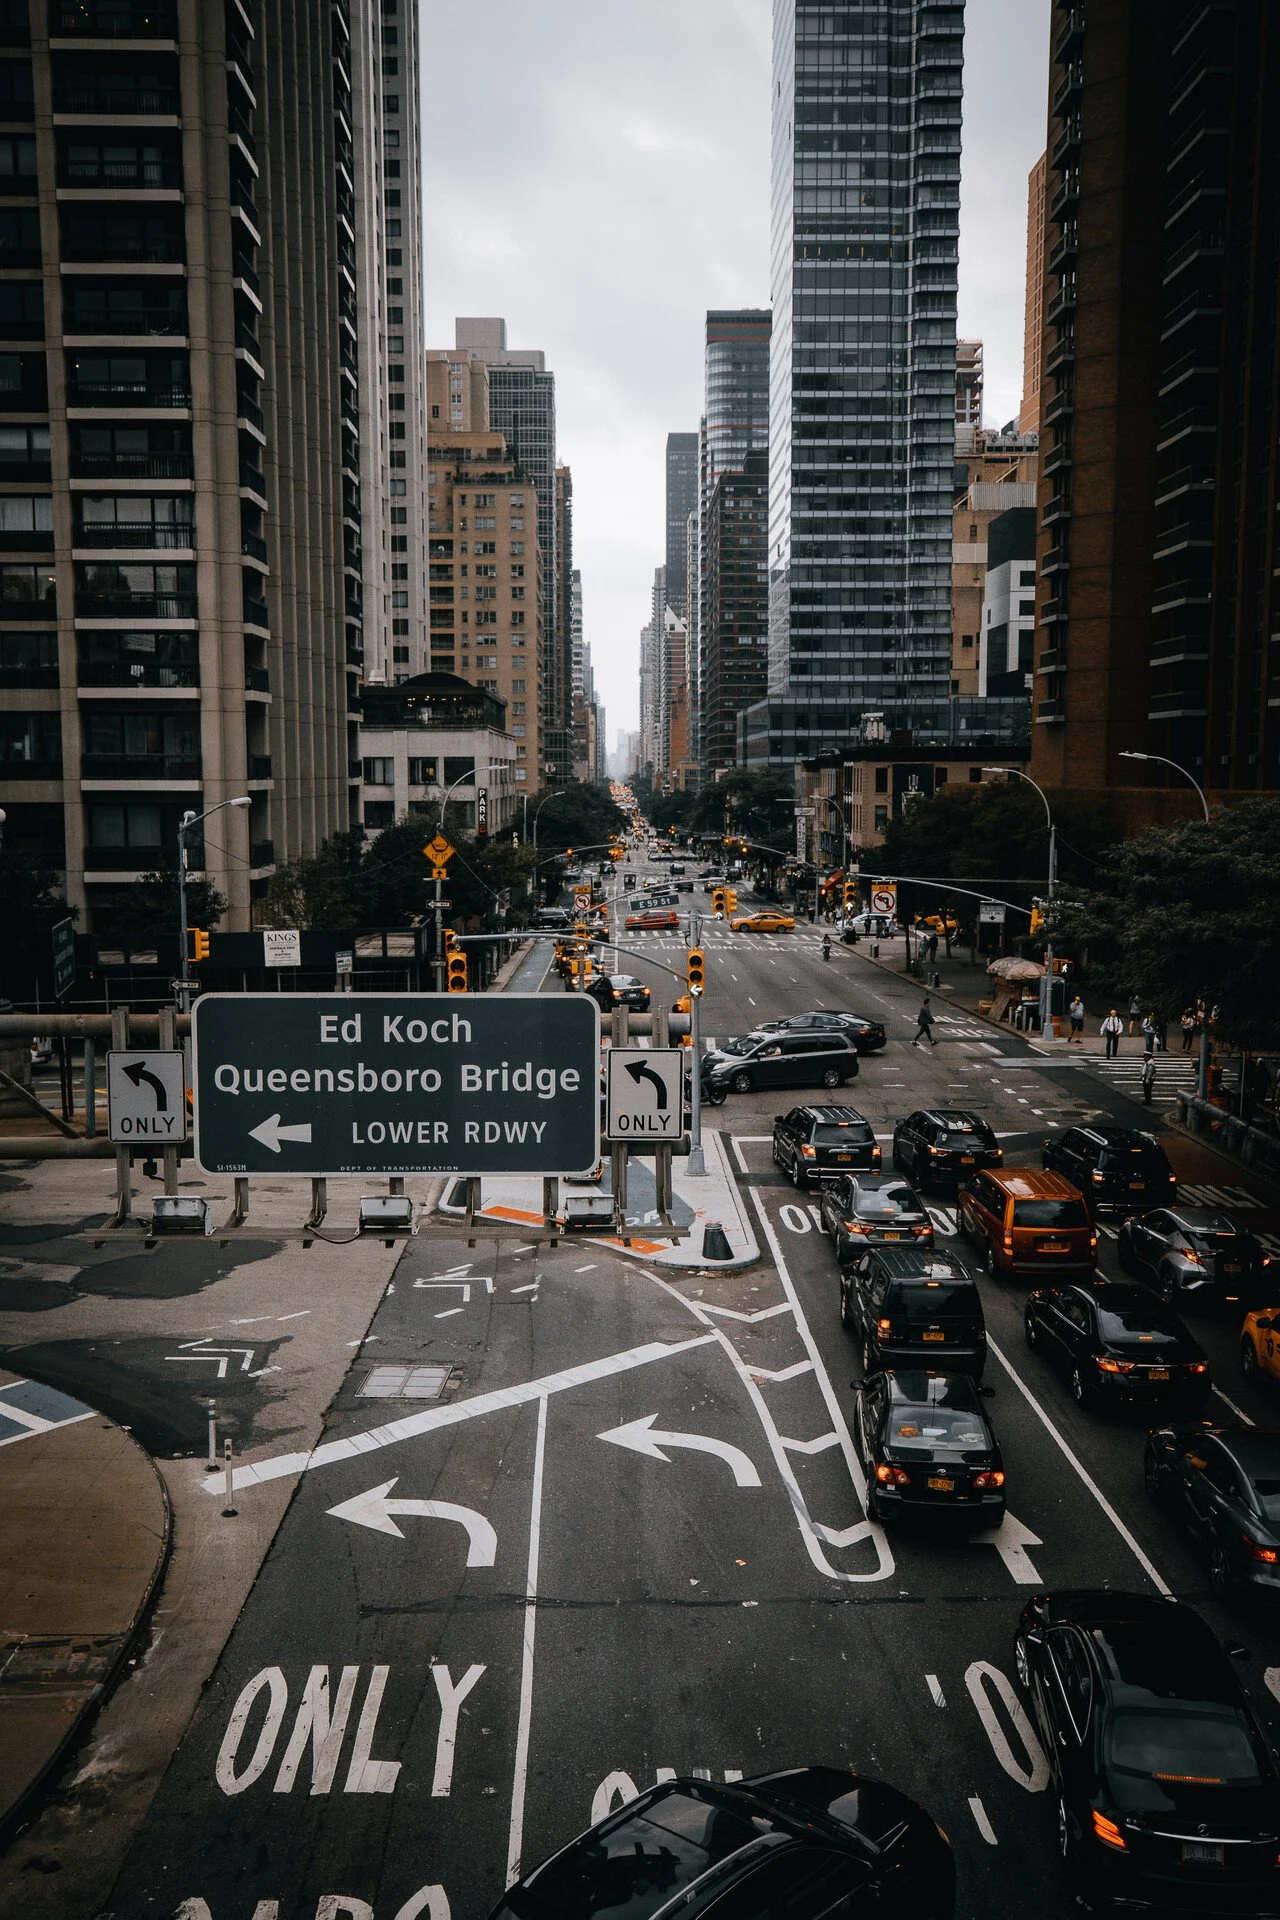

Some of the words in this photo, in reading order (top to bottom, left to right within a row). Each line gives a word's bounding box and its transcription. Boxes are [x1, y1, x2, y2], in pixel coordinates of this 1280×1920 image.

[267, 933, 297, 942] KINGS
[320, 1013, 362, 1043] Ed
[384, 1013, 472, 1043] Koch
[214, 1062, 442, 1096] Queensboro
[461, 1061, 580, 1100] Bridge
[120, 1116, 175, 1135] ONLY
[352, 1121, 449, 1144] LOWER
[464, 1121, 547, 1144] RDWY
[618, 1114, 672, 1132] ONLY
[216, 1665, 488, 1797] ONLY
